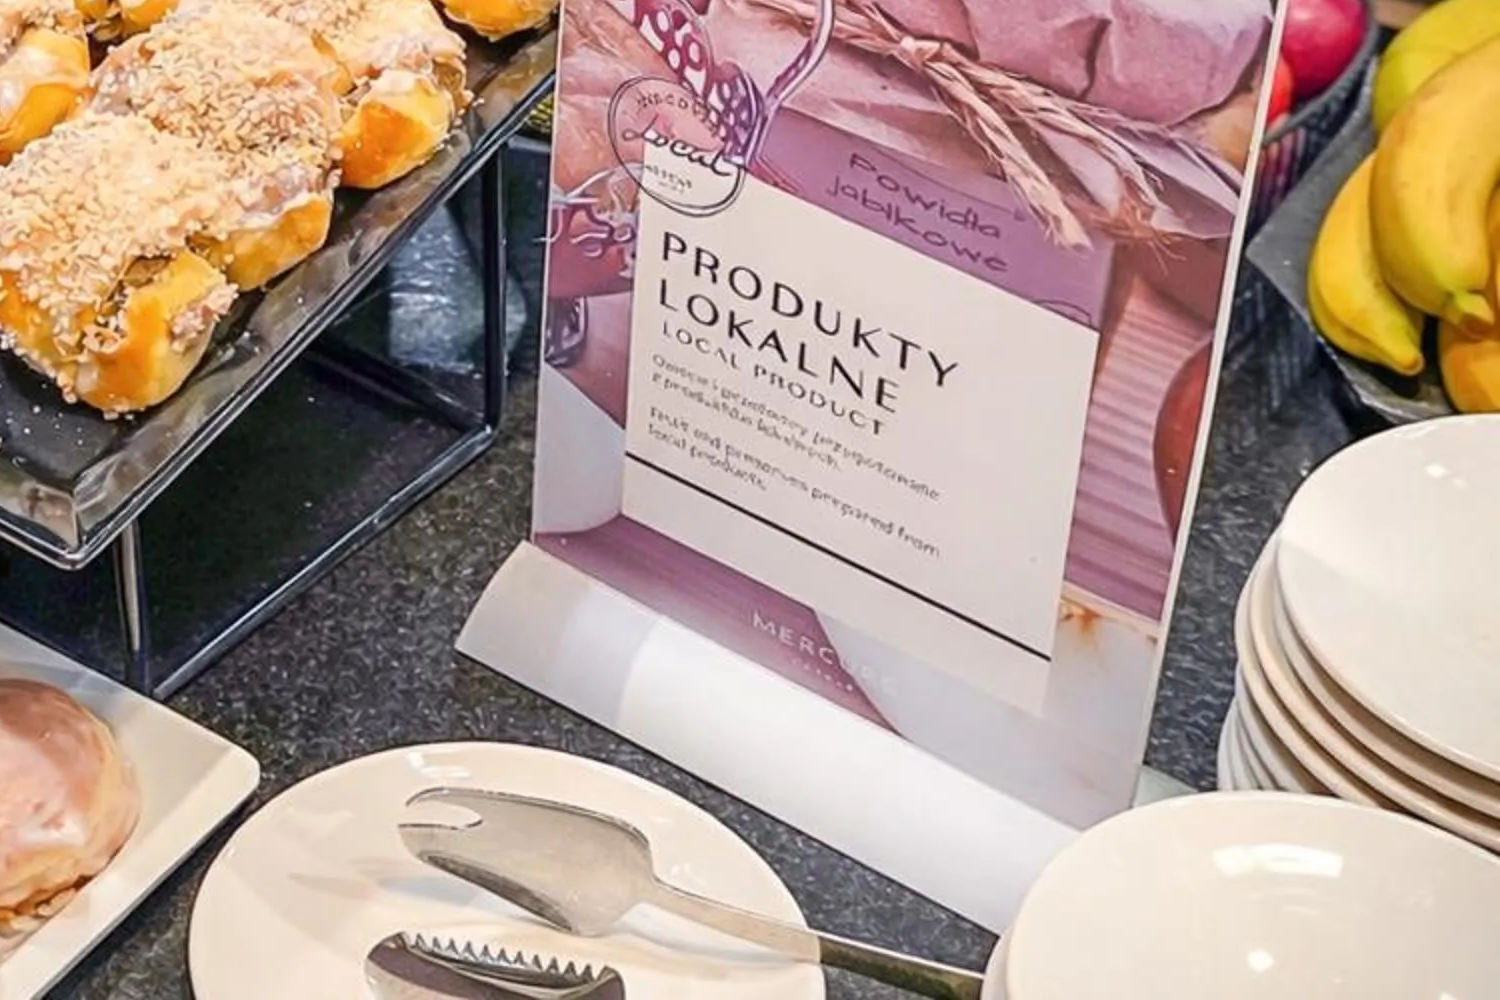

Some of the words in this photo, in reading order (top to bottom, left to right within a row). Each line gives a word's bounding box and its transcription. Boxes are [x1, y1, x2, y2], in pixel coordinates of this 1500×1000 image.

[659, 278, 900, 414] LOKALNE
[662, 231, 958, 388] PRODUKTY
[662, 320, 741, 370] LOCAL
[753, 363, 885, 436] PRODUCT
